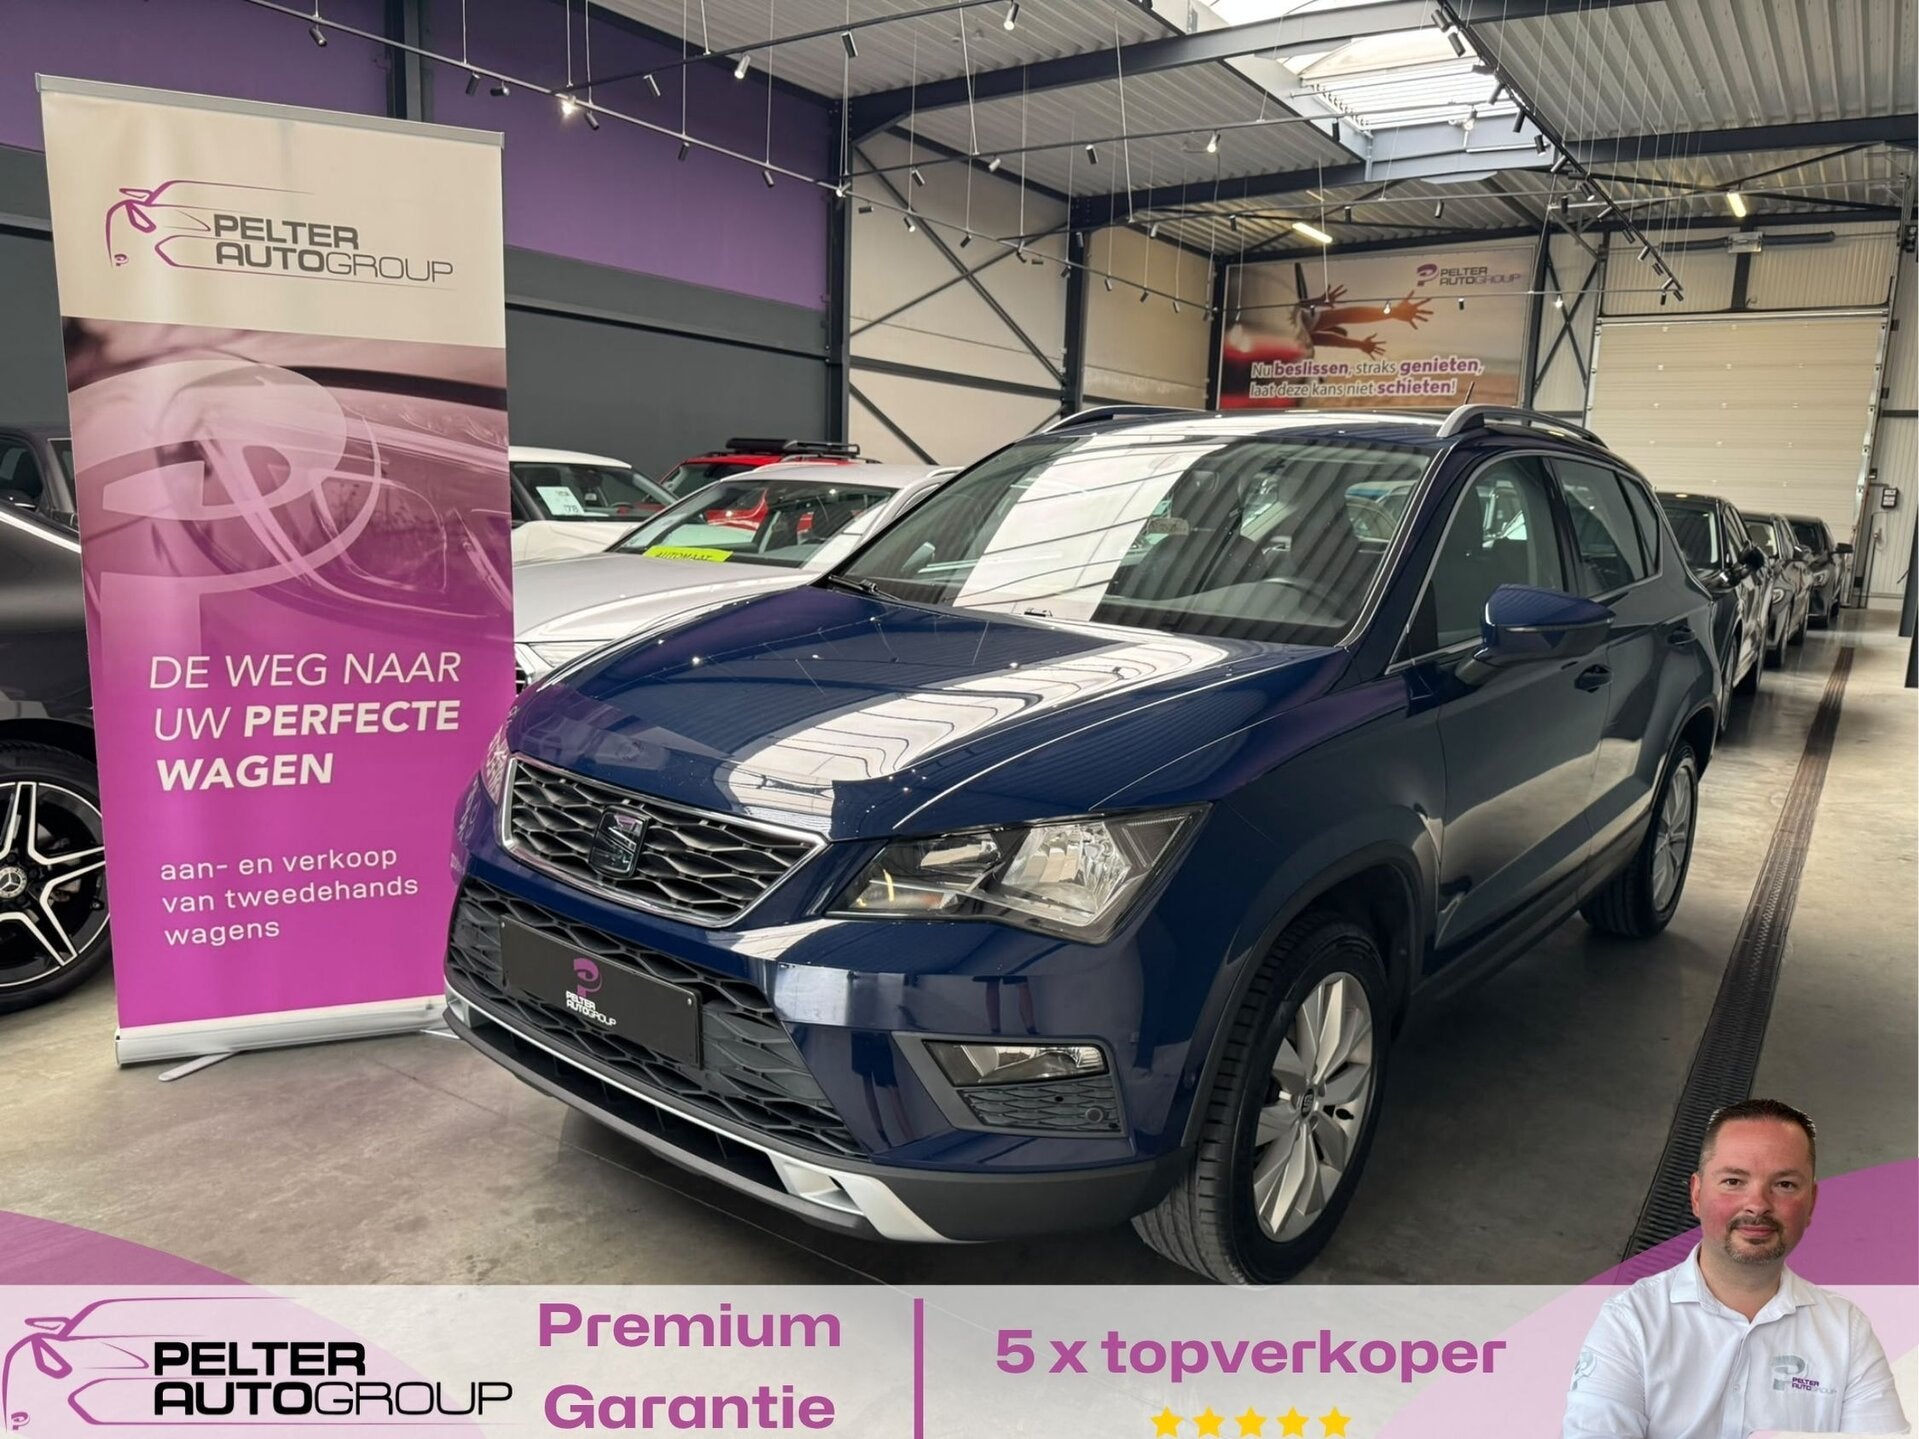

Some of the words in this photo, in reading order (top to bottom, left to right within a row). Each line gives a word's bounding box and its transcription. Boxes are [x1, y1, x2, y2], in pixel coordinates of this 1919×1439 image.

[214, 213, 360, 250] PELTER
[216, 241, 454, 283] AUTOGROUP
[1440, 266, 1488, 277] PELTER
[1252, 363, 1272, 377] Nu
[1274, 361, 1352, 377] beslissen,
[1355, 359, 1396, 375] straks
[1400, 357, 1484, 376] genieten,
[1250, 384, 1275, 397] laat
[1277, 382, 1309, 397] deze
[1312, 382, 1343, 396] kans
[1346, 380, 1375, 395] niet
[1377, 378, 1456, 395] schieten!
[149, 655, 210, 689] DE
[225, 653, 328, 687] WEG
[343, 651, 462, 685] NAAR
[154, 706, 231, 742] UW
[244, 700, 461, 738] PERFECTE
[156, 752, 334, 791] WAGEN
[160, 861, 228, 881] aan-
[238, 856, 273, 876] en
[283, 848, 397, 874] verkoop
[162, 893, 215, 914] van
[225, 876, 418, 910] tweedehands
[164, 920, 280, 947] wagens
[565, 990, 596, 1011] PELTER
[566, 999, 617, 1026] AUTOGROUP
[1792, 1376, 1820, 1387] PELTER
